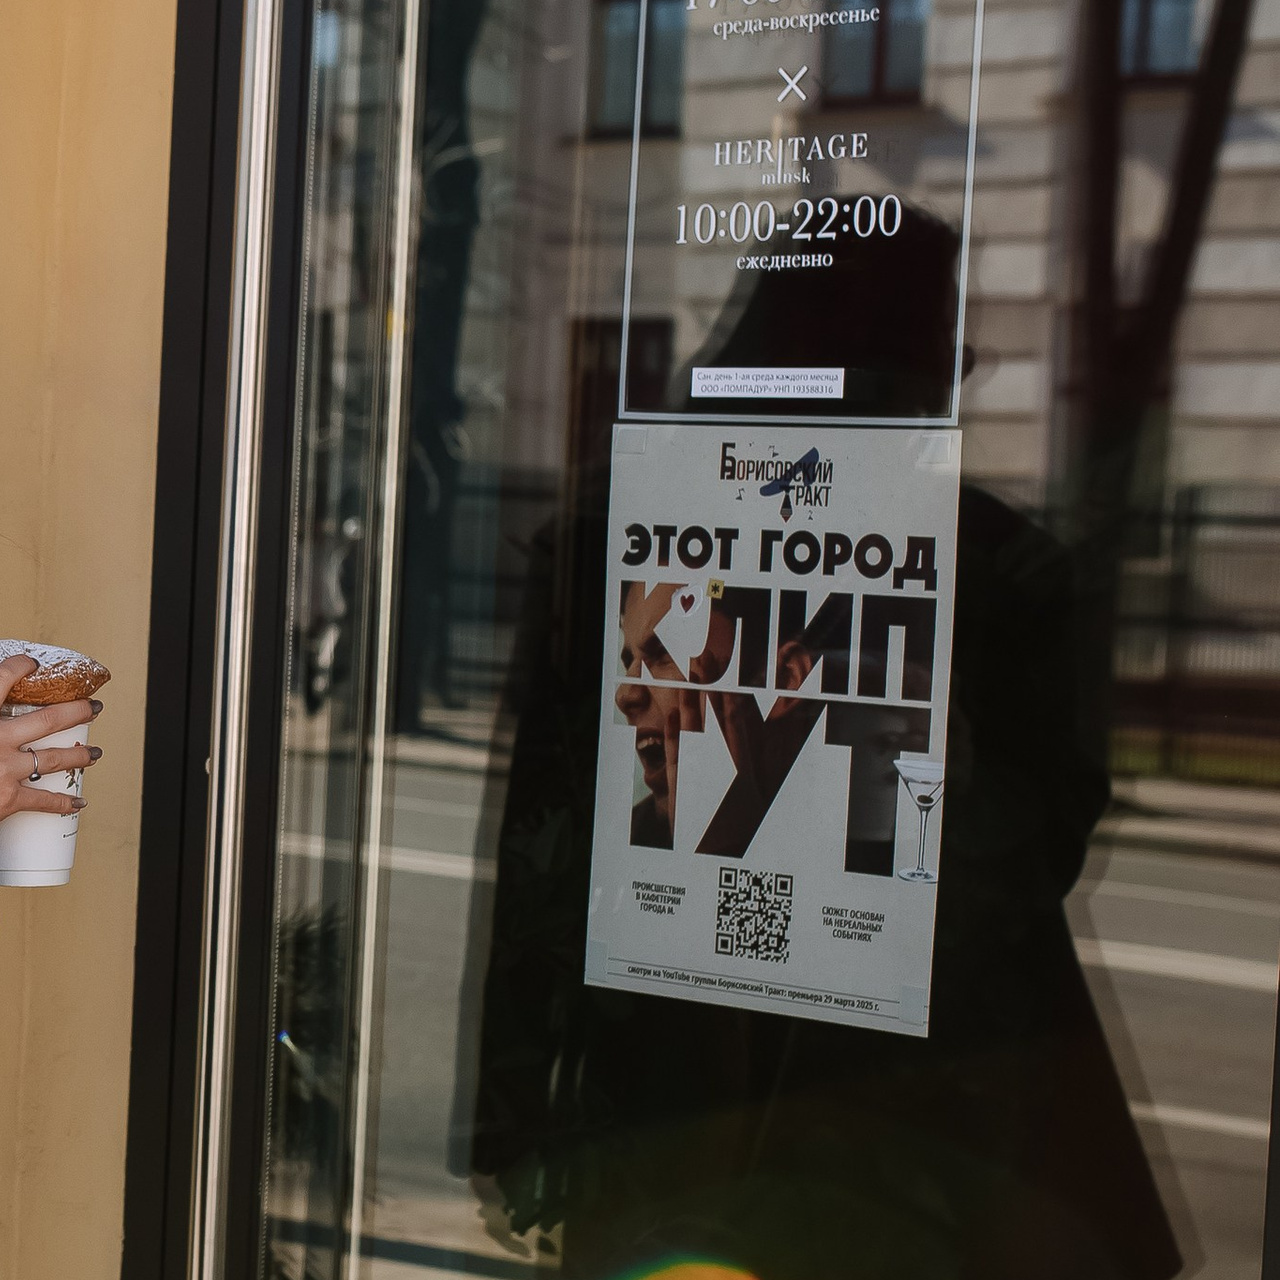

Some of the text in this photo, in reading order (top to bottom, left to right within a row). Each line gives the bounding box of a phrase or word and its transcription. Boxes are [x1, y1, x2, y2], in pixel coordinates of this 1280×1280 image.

[713, 6, 880, 40] среда-воскресенье
[714, 132, 868, 174] HERITAGE
[675, 194, 902, 245] 10:00-22:00
[736, 253, 833, 272] ежедневно
[752, 373, 774, 383] среда
[621, 522, 938, 592] ЭТОТ ГОРОД
[619, 579, 938, 703] КЛИП
[615, 682, 932, 878] ТУТ
[631, 880, 686, 896] ПРОИСШЕСТВИЯ
[821, 905, 885, 923] СЮЖЕТ ОСНОВАН
[822, 916, 883, 933] НА НЕРЕАЛЬНЫХ
[832, 928, 873, 943] СОБЫТИЯХ
[662, 969, 690, 982] YouTube
[823, 994, 833, 1004] 29
[856, 999, 874, 1011] 2025
